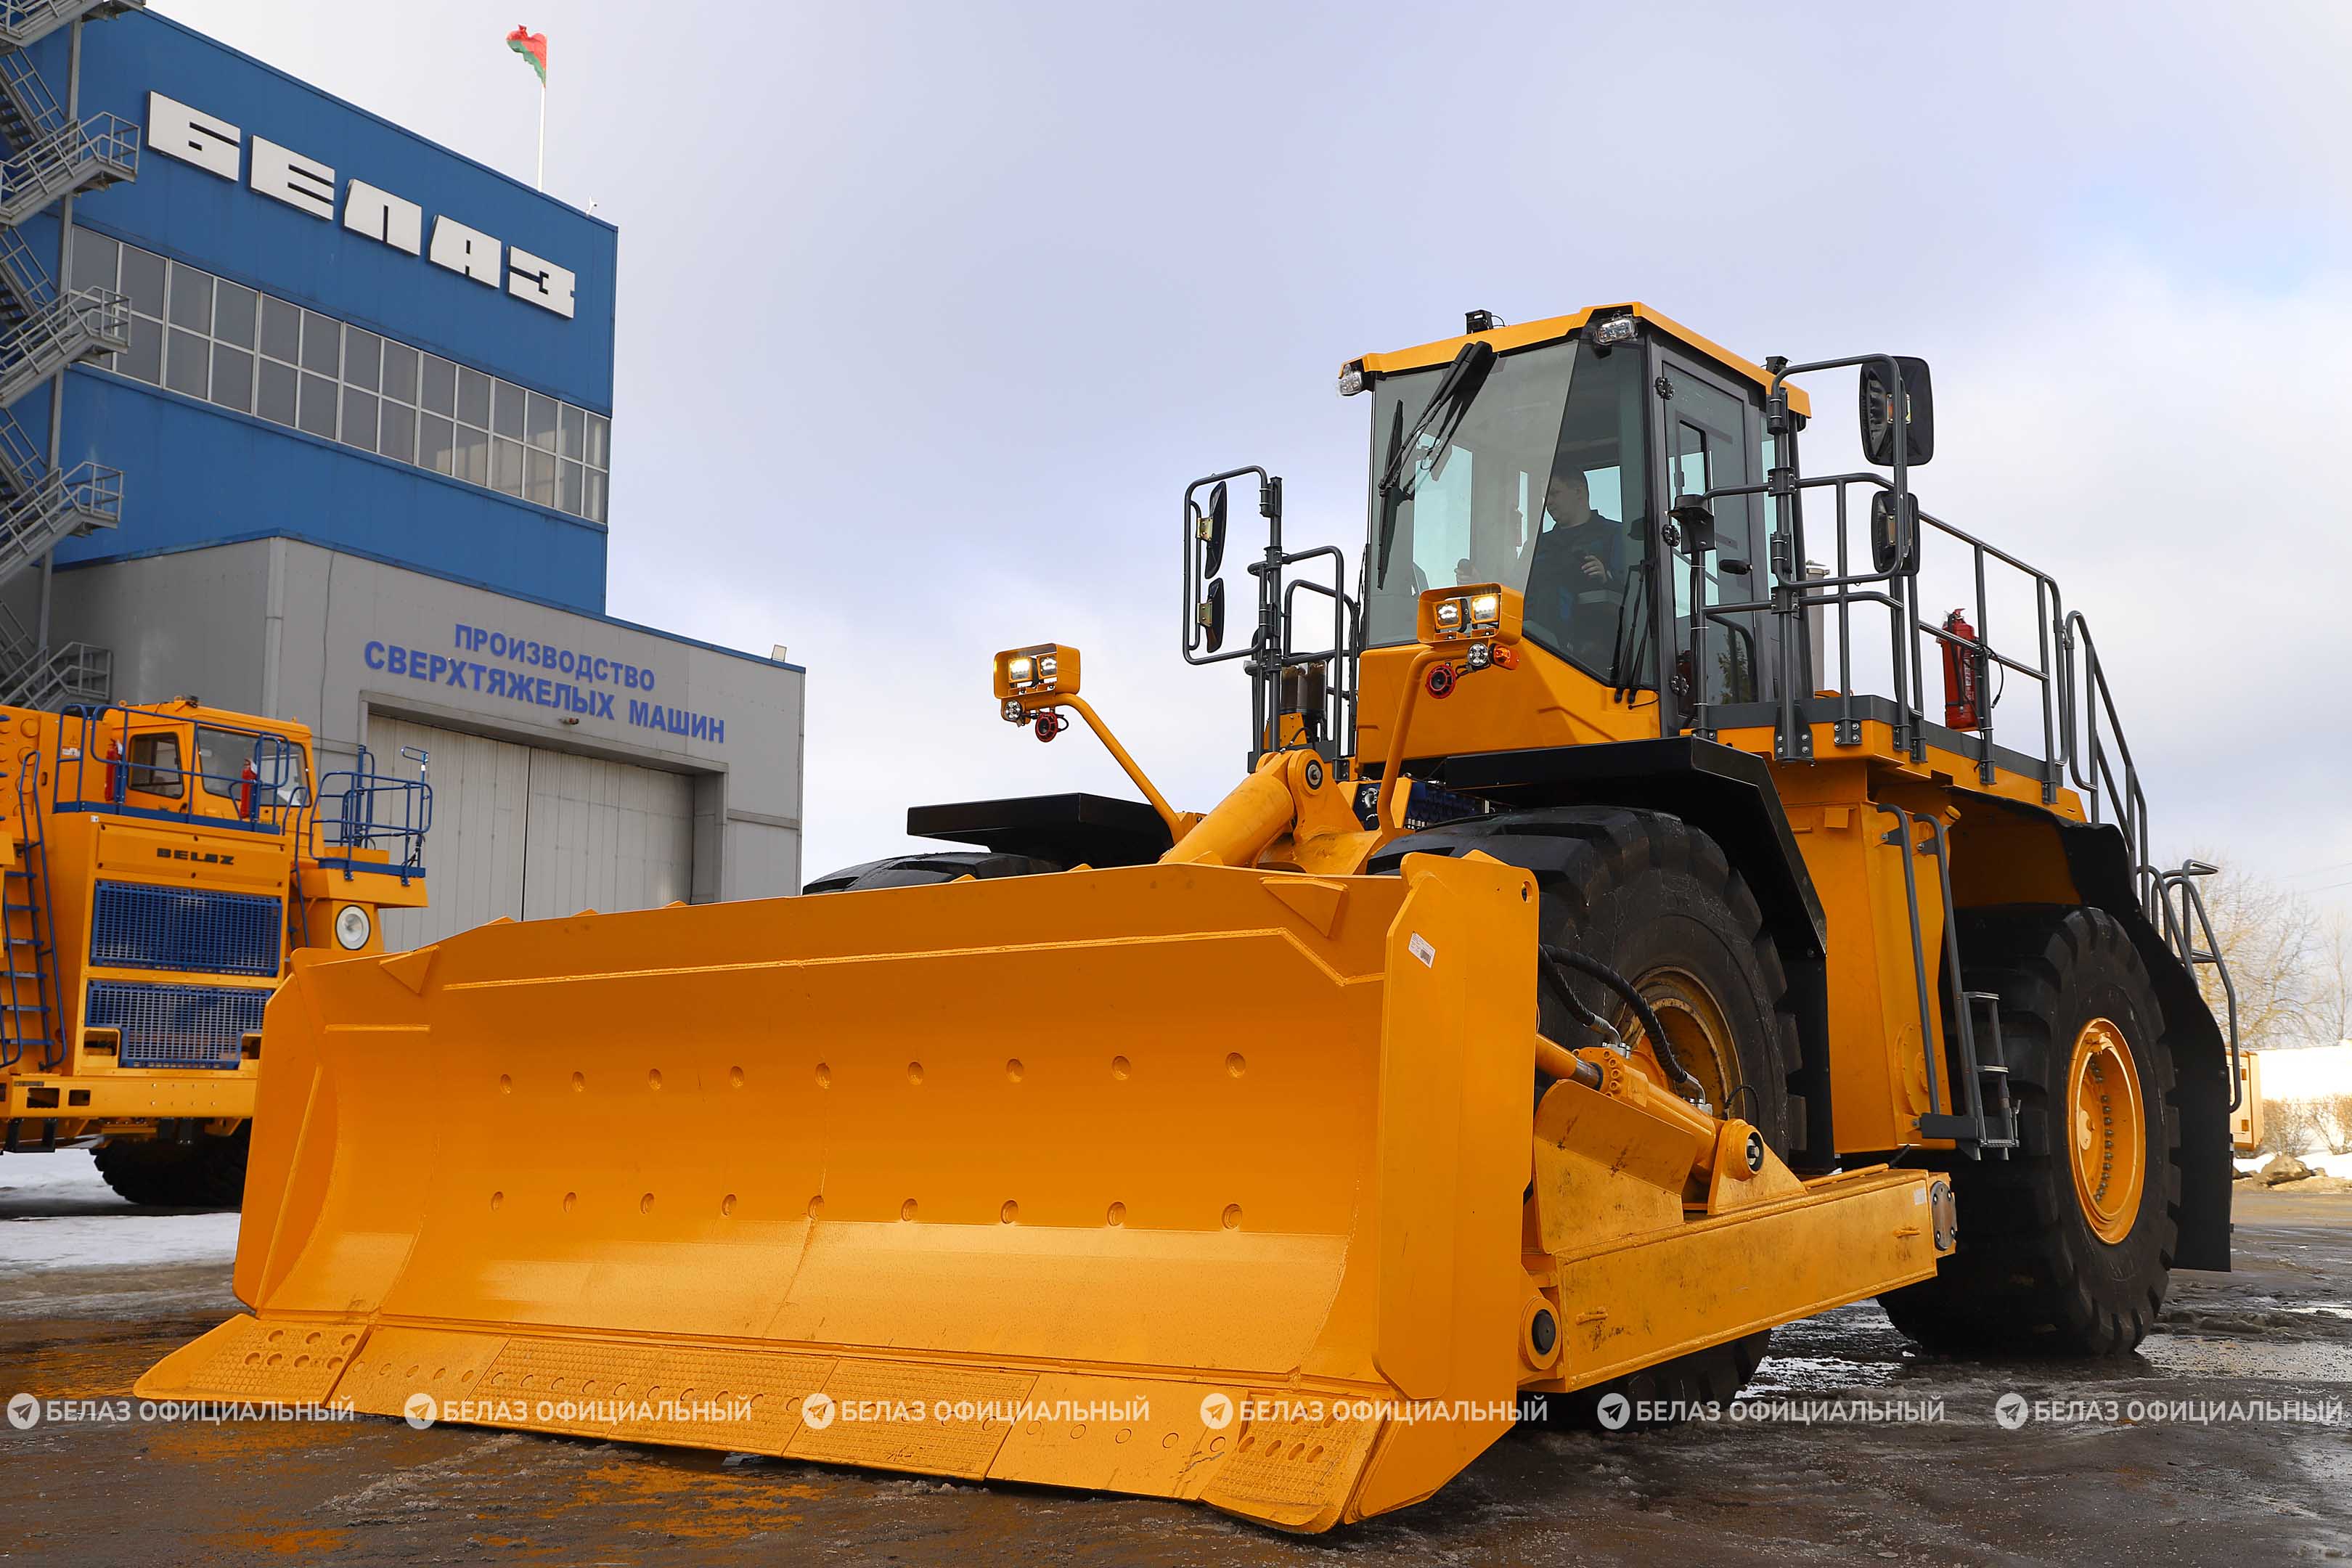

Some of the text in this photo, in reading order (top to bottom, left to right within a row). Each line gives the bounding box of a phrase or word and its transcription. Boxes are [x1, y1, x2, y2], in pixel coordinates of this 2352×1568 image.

[147, 90, 576, 319] БЕЛАЗ
[364, 640, 725, 744] СВЕРХТЯЖЕЛЫХ МАШИН
[454, 623, 656, 692] ПРОИЗВОДСТВО
[156, 847, 234, 865] BELAZ
